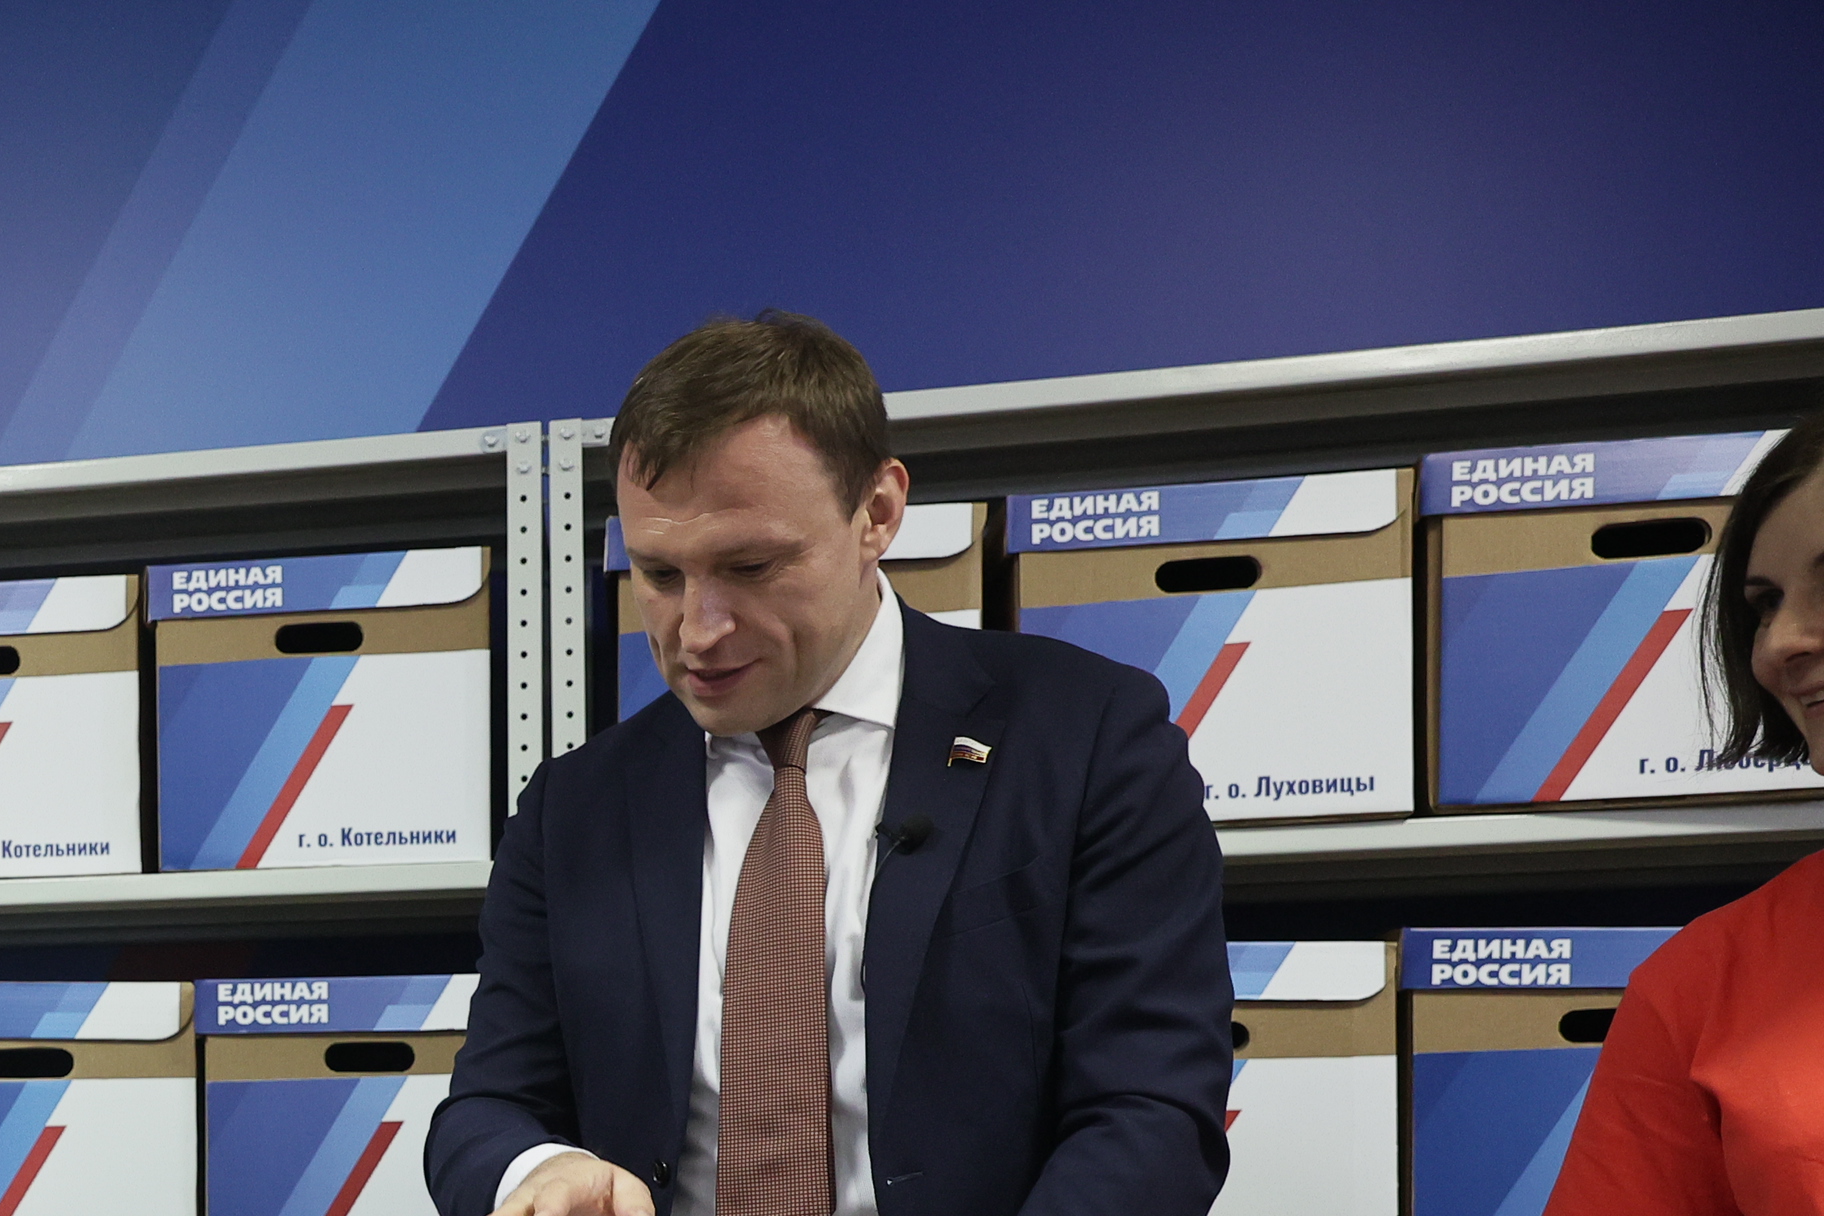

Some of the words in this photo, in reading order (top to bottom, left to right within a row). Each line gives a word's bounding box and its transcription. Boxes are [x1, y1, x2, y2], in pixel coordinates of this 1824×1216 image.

[1451, 452, 1595, 483] ЕДИНАЯ
[1451, 476, 1595, 508] РОССИЯ
[1031, 490, 1160, 521] ЕДИНАЯ
[1031, 514, 1160, 545] РОССИЯ
[172, 565, 283, 591] ЕДИНАЯ
[172, 587, 283, 614] РОССИЯ
[1639, 758, 1656, 775] г.
[1665, 756, 1684, 773] о.
[1203, 784, 1220, 800] г.
[1227, 783, 1246, 799] о.
[1254, 775, 1374, 801] Луховицы
[1, 840, 110, 859] Котельники
[298, 833, 311, 848] г.
[318, 833, 333, 848] о.
[341, 827, 456, 847] Котельники
[1432, 938, 1572, 962] ЕДИНАЯ
[1431, 963, 1571, 986] РОССИЯ
[217, 981, 329, 1004] ЕДИНАЯ
[217, 1003, 329, 1026] РОССИЯ
